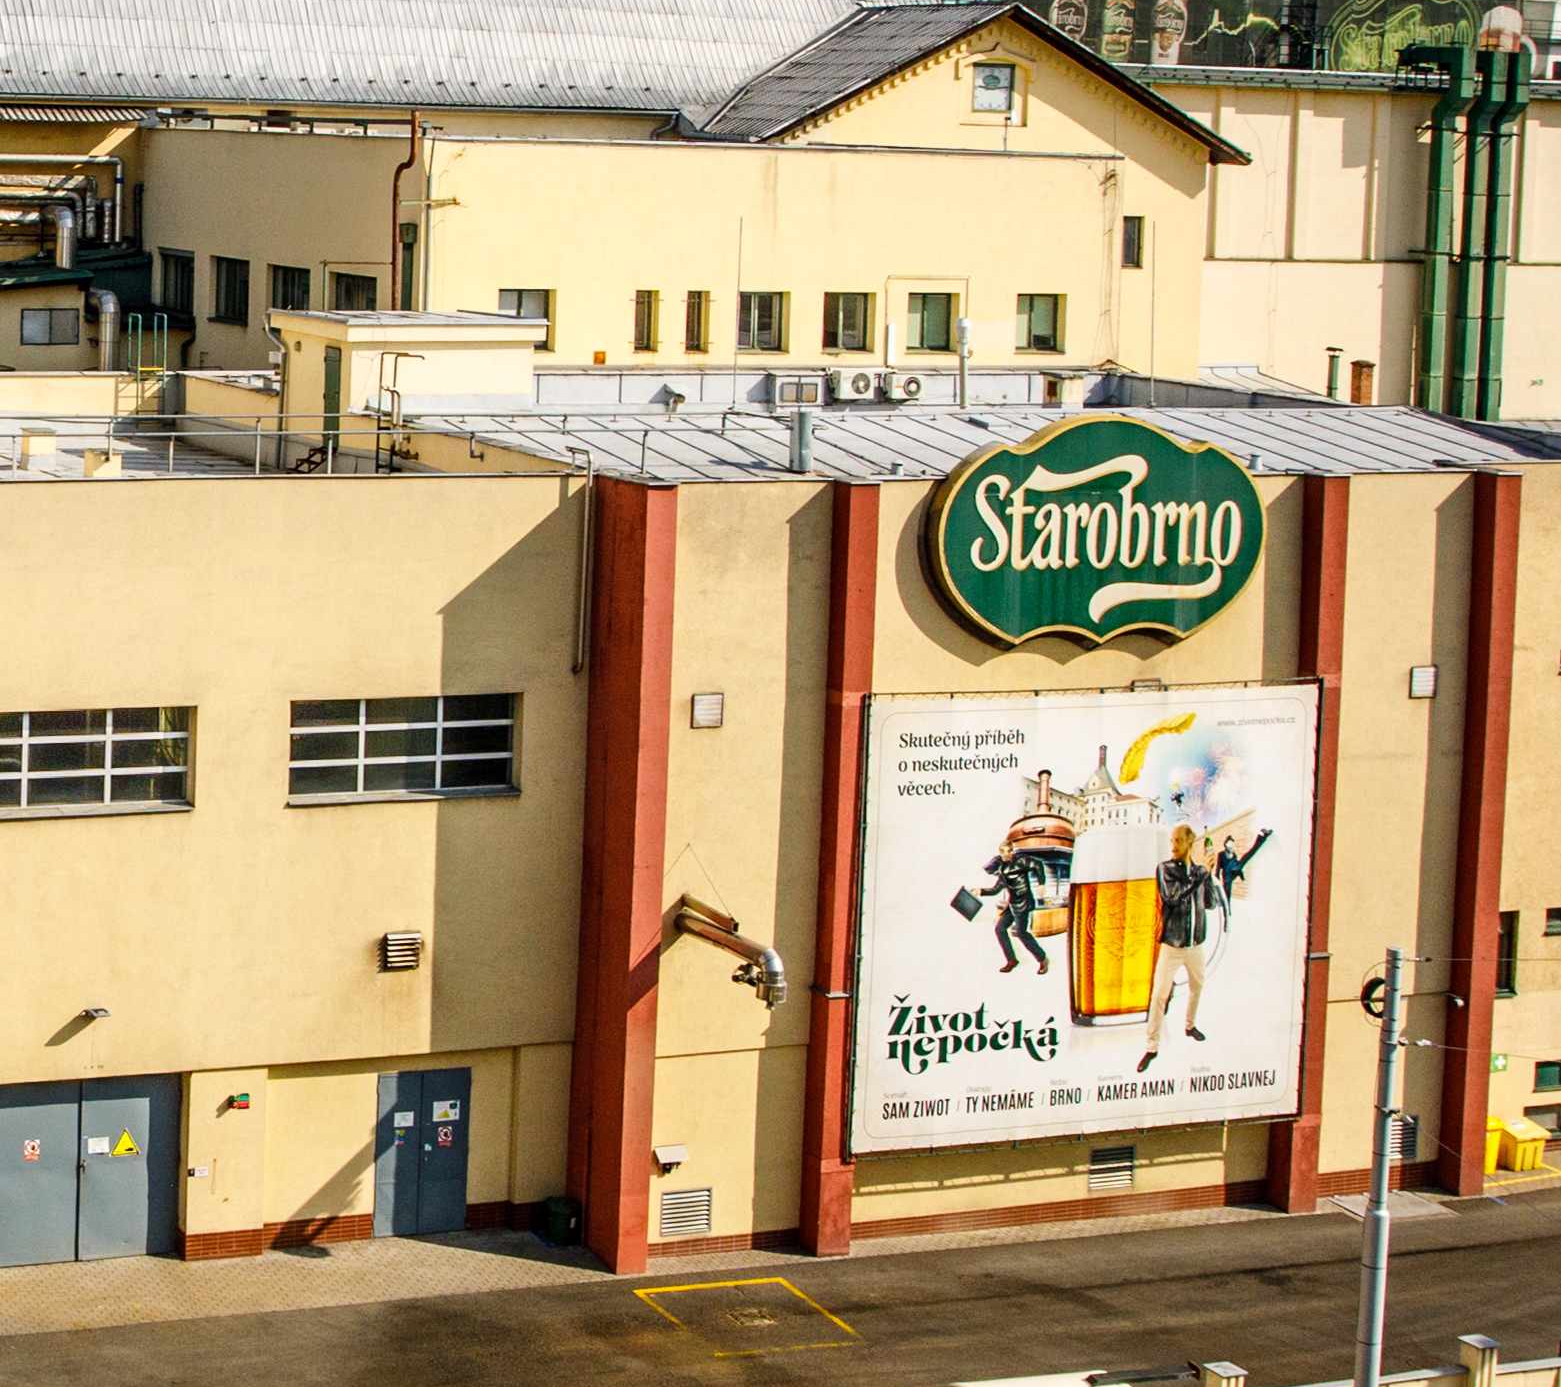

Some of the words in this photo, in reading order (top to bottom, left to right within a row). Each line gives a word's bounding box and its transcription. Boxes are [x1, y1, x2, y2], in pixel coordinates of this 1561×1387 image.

[970, 454, 1243, 624] Starobrno
[899, 731, 971, 750] Skutečný
[975, 729, 1025, 749] příběh
[898, 760, 908, 773] o
[912, 753, 1018, 773] neskutečných
[897, 780, 956, 797] věcech.
[887, 993, 990, 1036] Život
[885, 1016, 1061, 1075] nepočká
[882, 1101, 910, 1120] SAM
[913, 1098, 950, 1118] ZIWOT
[966, 1096, 979, 1113] TY
[982, 1089, 1034, 1112] NEMÁME
[1050, 1087, 1082, 1106] BRNO
[1097, 1082, 1137, 1102] KAMER
[1140, 1079, 1175, 1099] AMAN
[1190, 1074, 1225, 1093] NIKDO
[1228, 1069, 1276, 1089] SLAVNEJ
